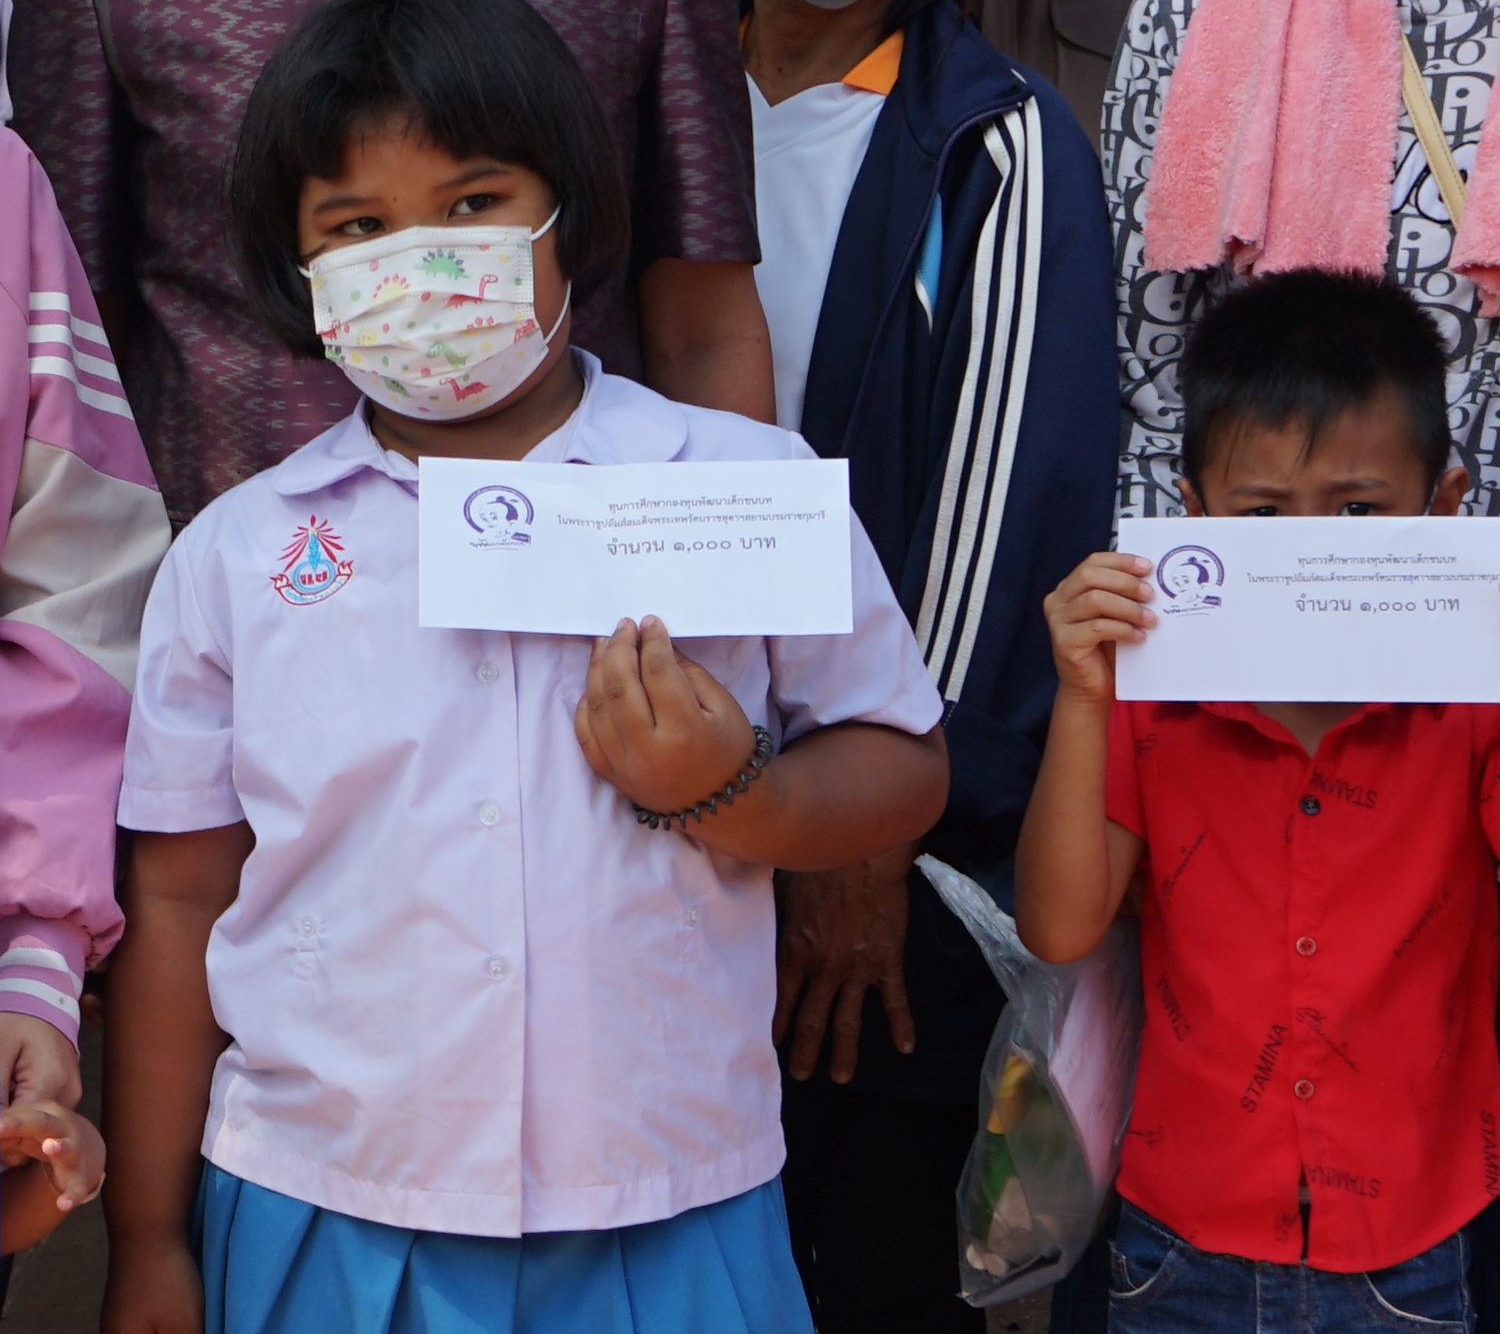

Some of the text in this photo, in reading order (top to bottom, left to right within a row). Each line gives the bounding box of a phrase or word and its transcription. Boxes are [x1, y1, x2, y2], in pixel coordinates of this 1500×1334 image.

[606, 535, 777, 557] จำนวน ๑,๐๐๐ บาท
[1295, 593, 1460, 615] จำนวน ๑,๐๐๐ บาท
[1240, 1022, 1289, 1115] STAMINA
